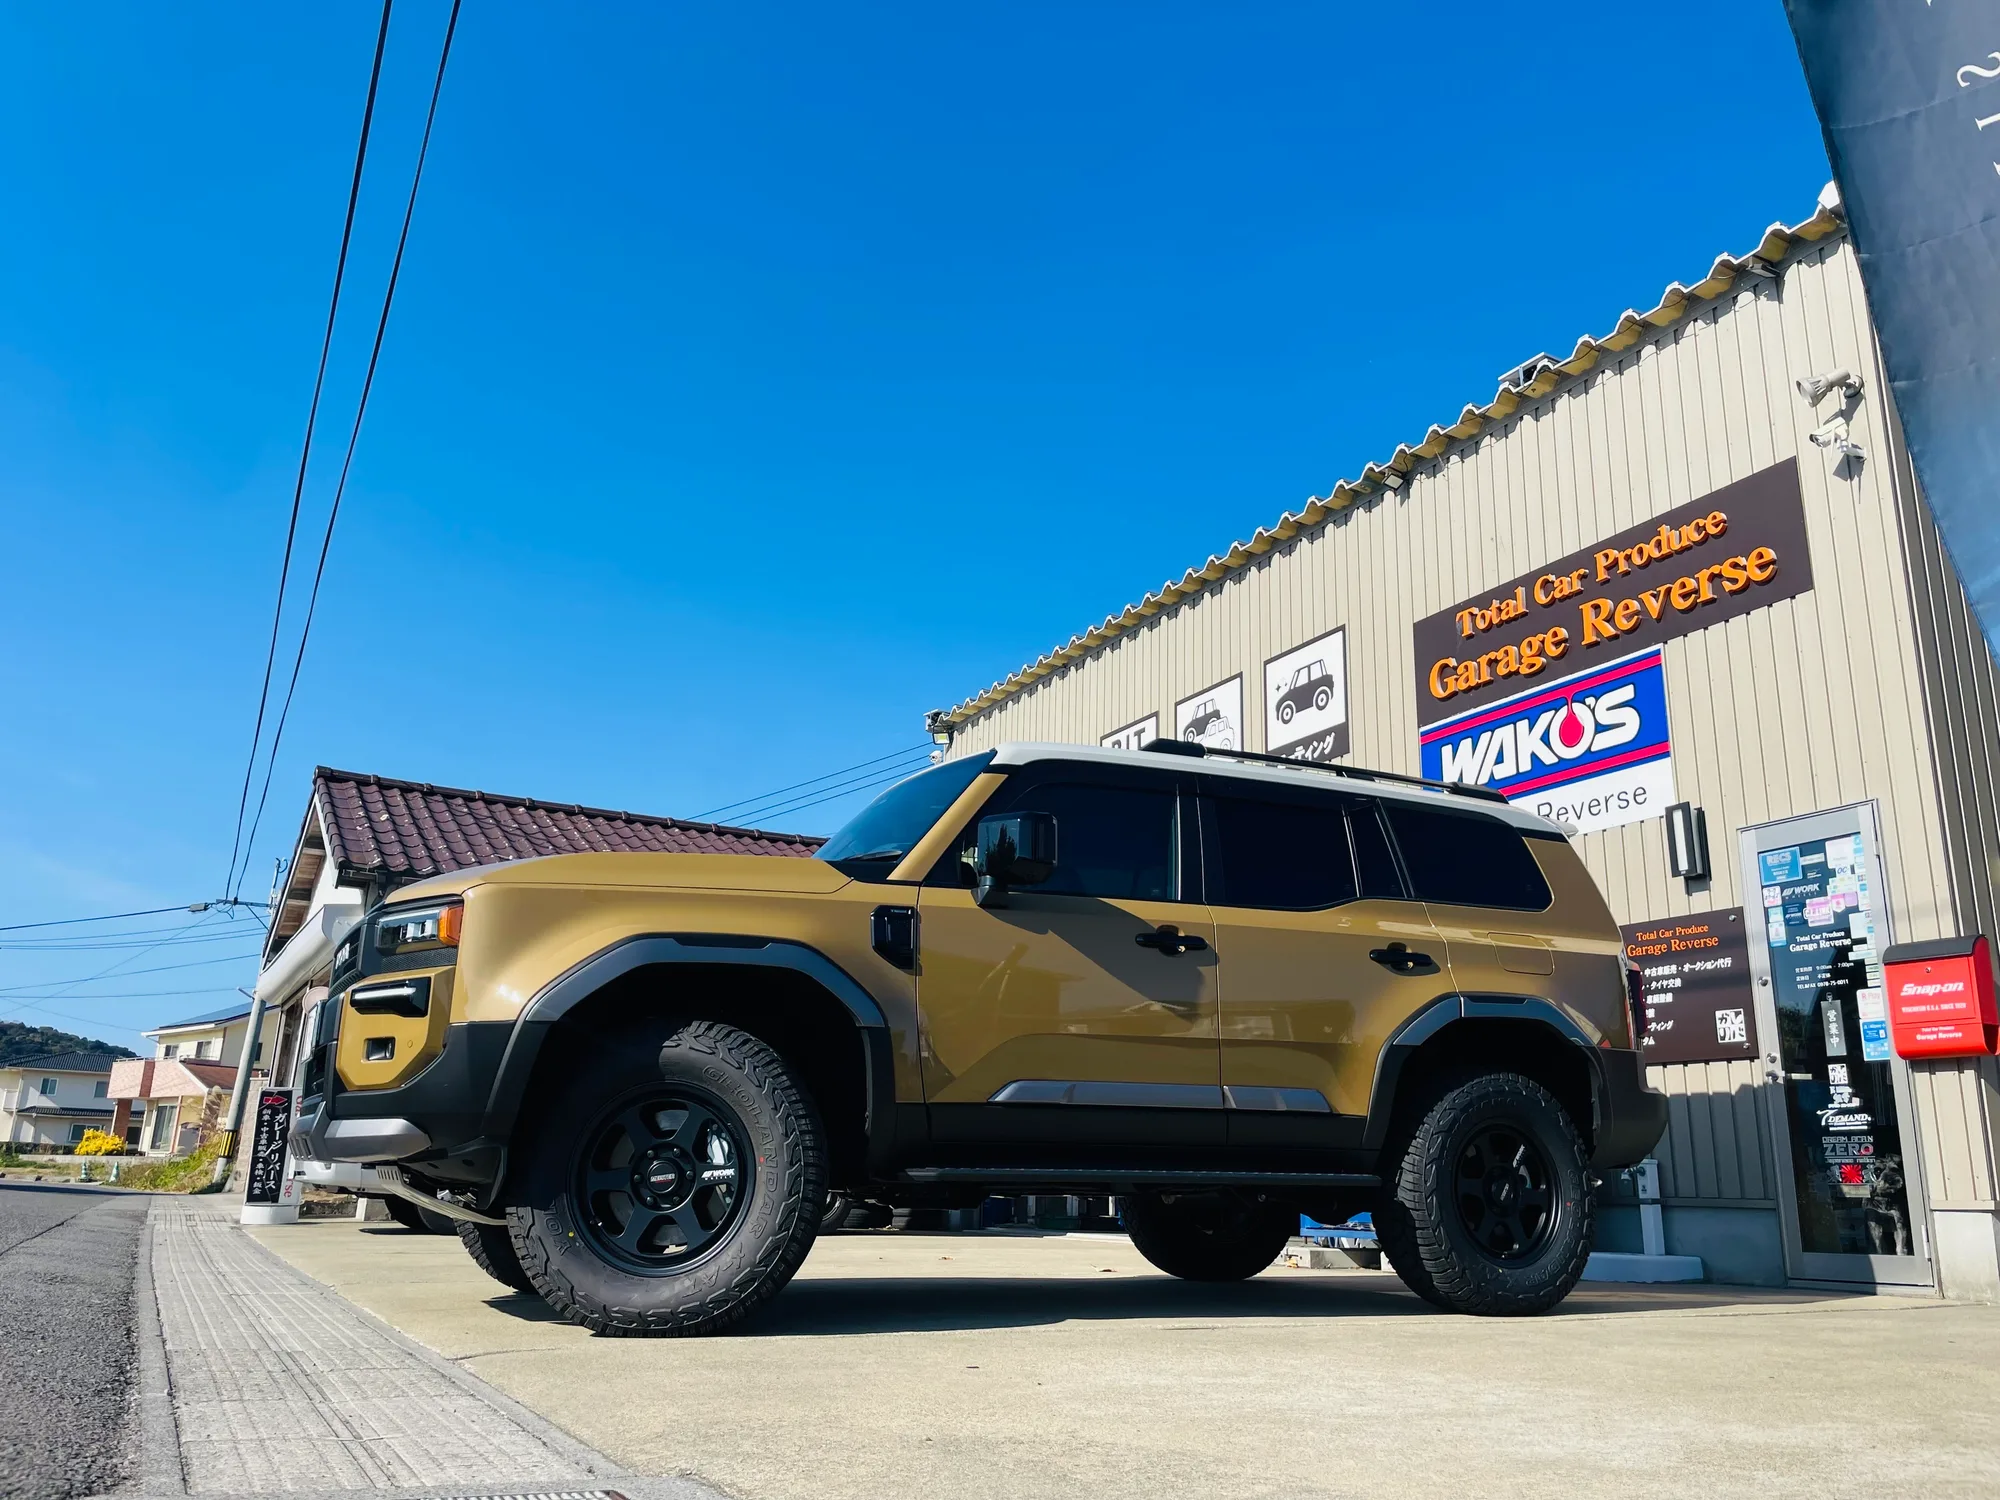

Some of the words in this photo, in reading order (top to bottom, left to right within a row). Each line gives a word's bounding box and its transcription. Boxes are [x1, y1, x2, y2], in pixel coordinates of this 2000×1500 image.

[1455, 586, 1529, 639] Total
[1533, 567, 1589, 606] Car
[1594, 510, 1728, 584] Produce
[1429, 624, 1569, 700] Garage
[1579, 546, 1778, 646] Reverse
[1441, 683, 1641, 786] WAKO'S
[1537, 786, 1648, 823] Reverse
[1794, 883, 1820, 895] WORK
[1635, 930, 1657, 942] Total
[1659, 929, 1674, 938] Car
[1675, 924, 1709, 937] Produce
[1795, 934, 1811, 942] Total
[1822, 931, 1845, 939] Produce
[1627, 942, 1668, 957] Garage
[1670, 936, 1719, 952] Reverse
[1789, 943, 1818, 953] Garage
[1819, 938, 1852, 949] Reverse
[1900, 982, 1965, 997] Snap-on
[1826, 1009, 1840, 1048] 営業中
[1823, 1143, 1874, 1156] ZERO
